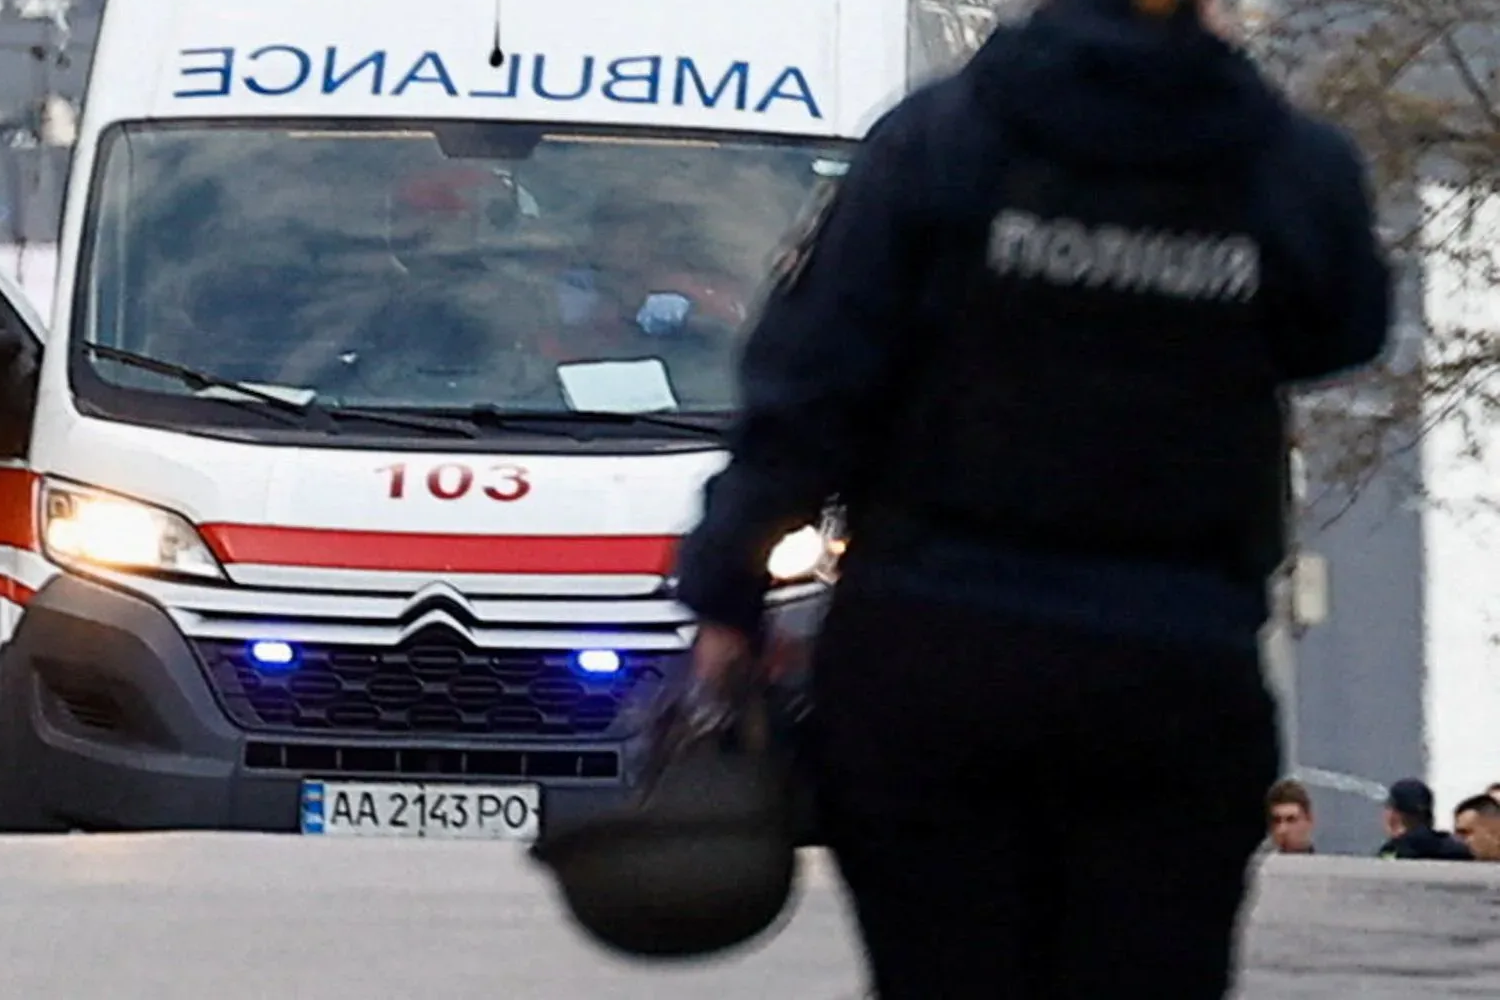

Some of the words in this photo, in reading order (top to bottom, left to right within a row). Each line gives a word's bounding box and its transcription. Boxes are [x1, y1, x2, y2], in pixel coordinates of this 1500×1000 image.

[373, 462, 531, 502] 103
[331, 791, 378, 826] AA
[389, 792, 468, 829] 2143
